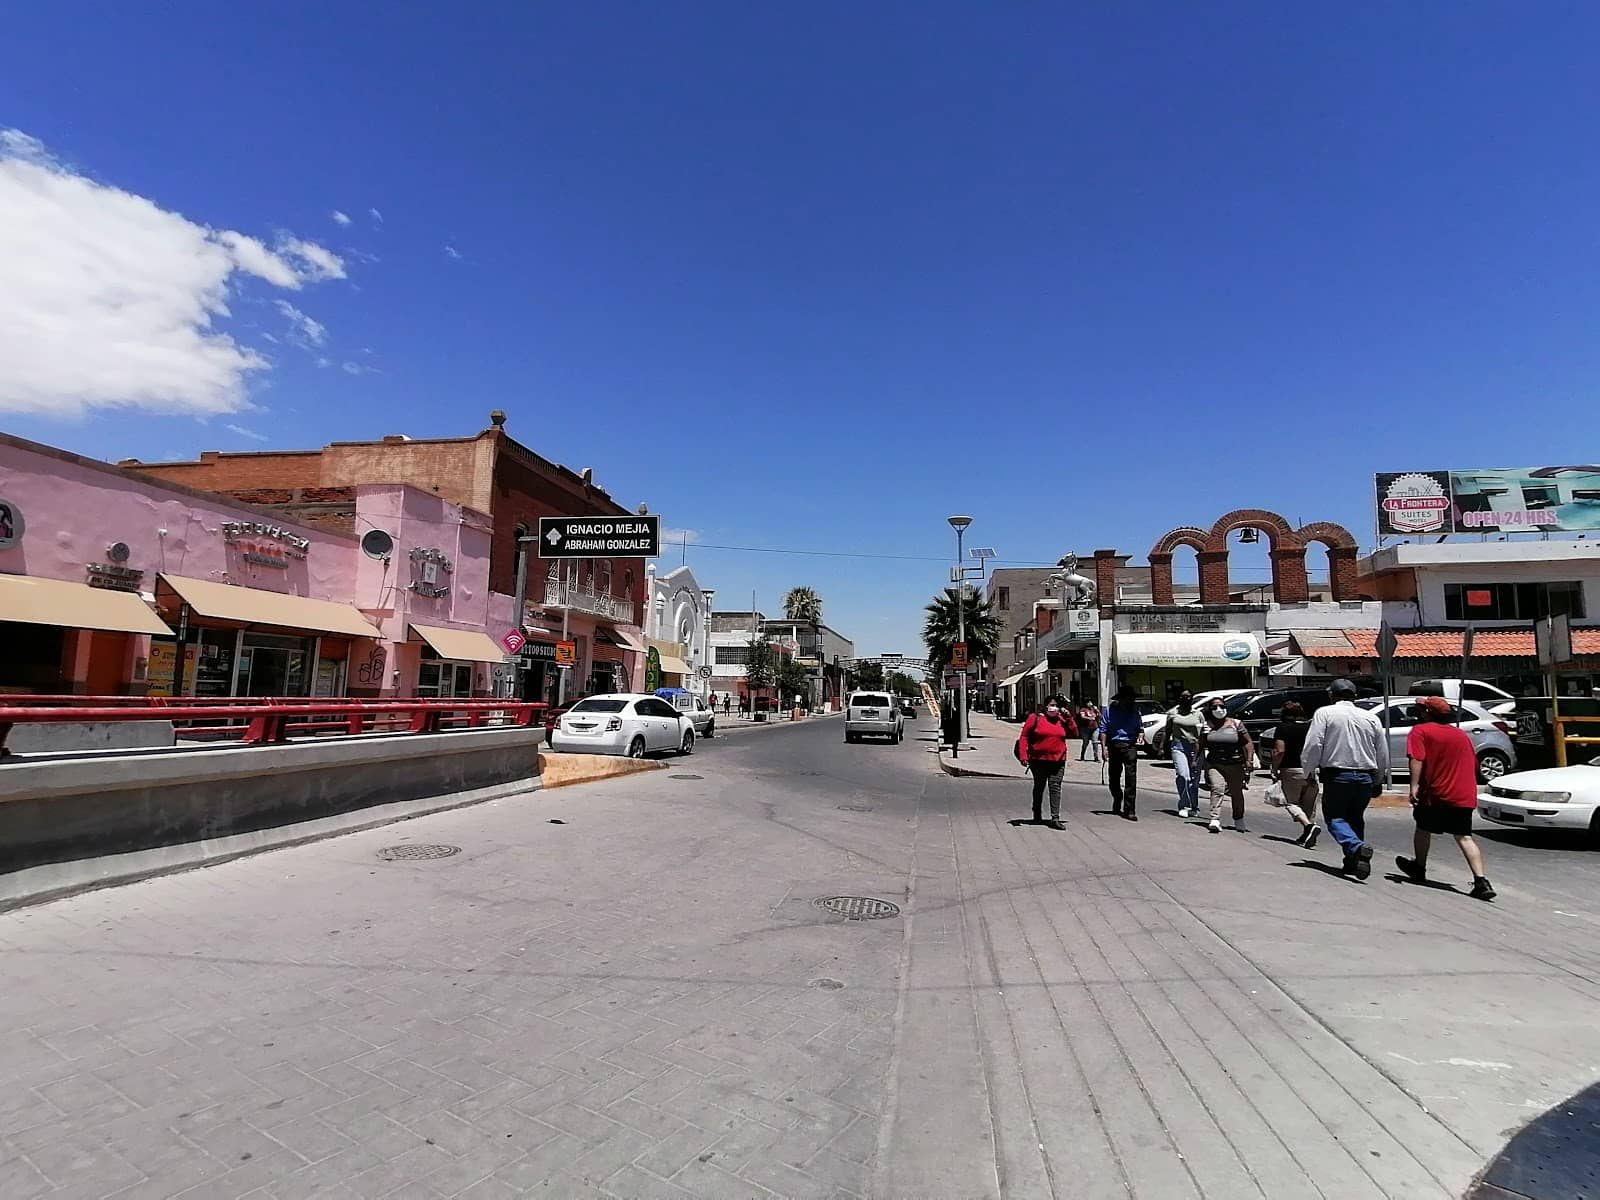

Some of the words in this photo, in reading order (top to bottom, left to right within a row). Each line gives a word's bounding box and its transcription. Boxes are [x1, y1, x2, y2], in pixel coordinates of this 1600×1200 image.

[1463, 511, 1500, 526] OPEN
[1504, 511, 1522, 525] 24
[566, 524, 613, 535] IGNACIO
[615, 523, 650, 534] MEJIA
[564, 539, 605, 550] ABRAHAM
[606, 539, 650, 550] GONZALEZ
